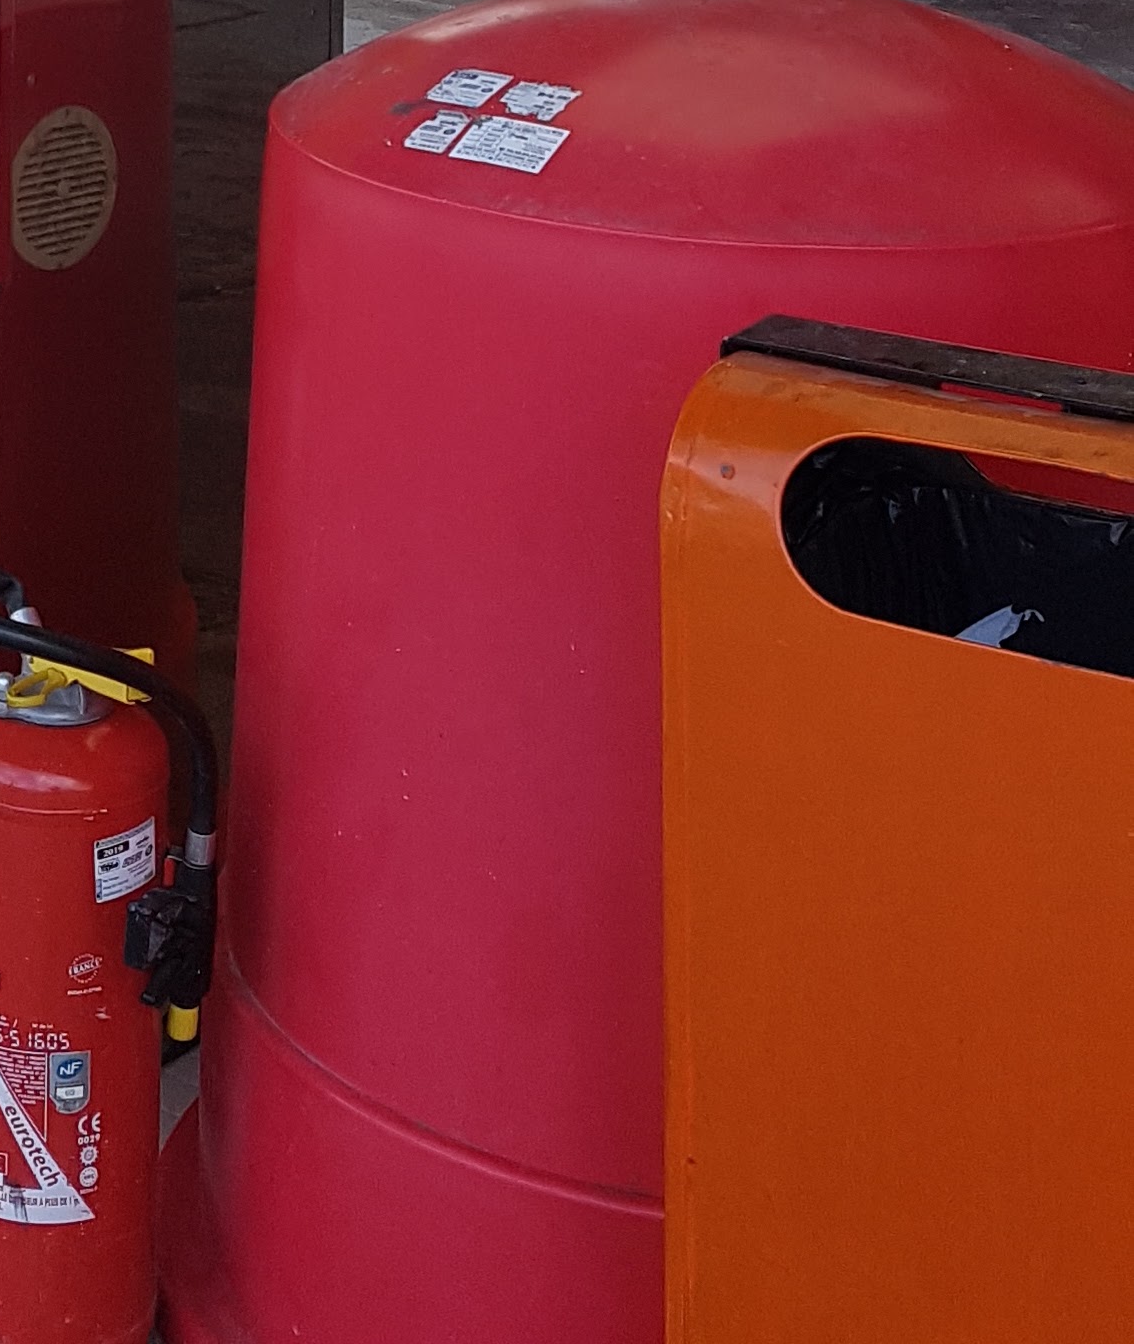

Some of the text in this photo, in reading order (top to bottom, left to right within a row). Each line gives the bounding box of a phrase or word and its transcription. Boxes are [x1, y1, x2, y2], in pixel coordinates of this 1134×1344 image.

[103, 844, 124, 858] 2019
[59, 1061, 83, 1076] NF
[78, 1112, 101, 1135] CE
[5, 1106, 60, 1187] eurotech
